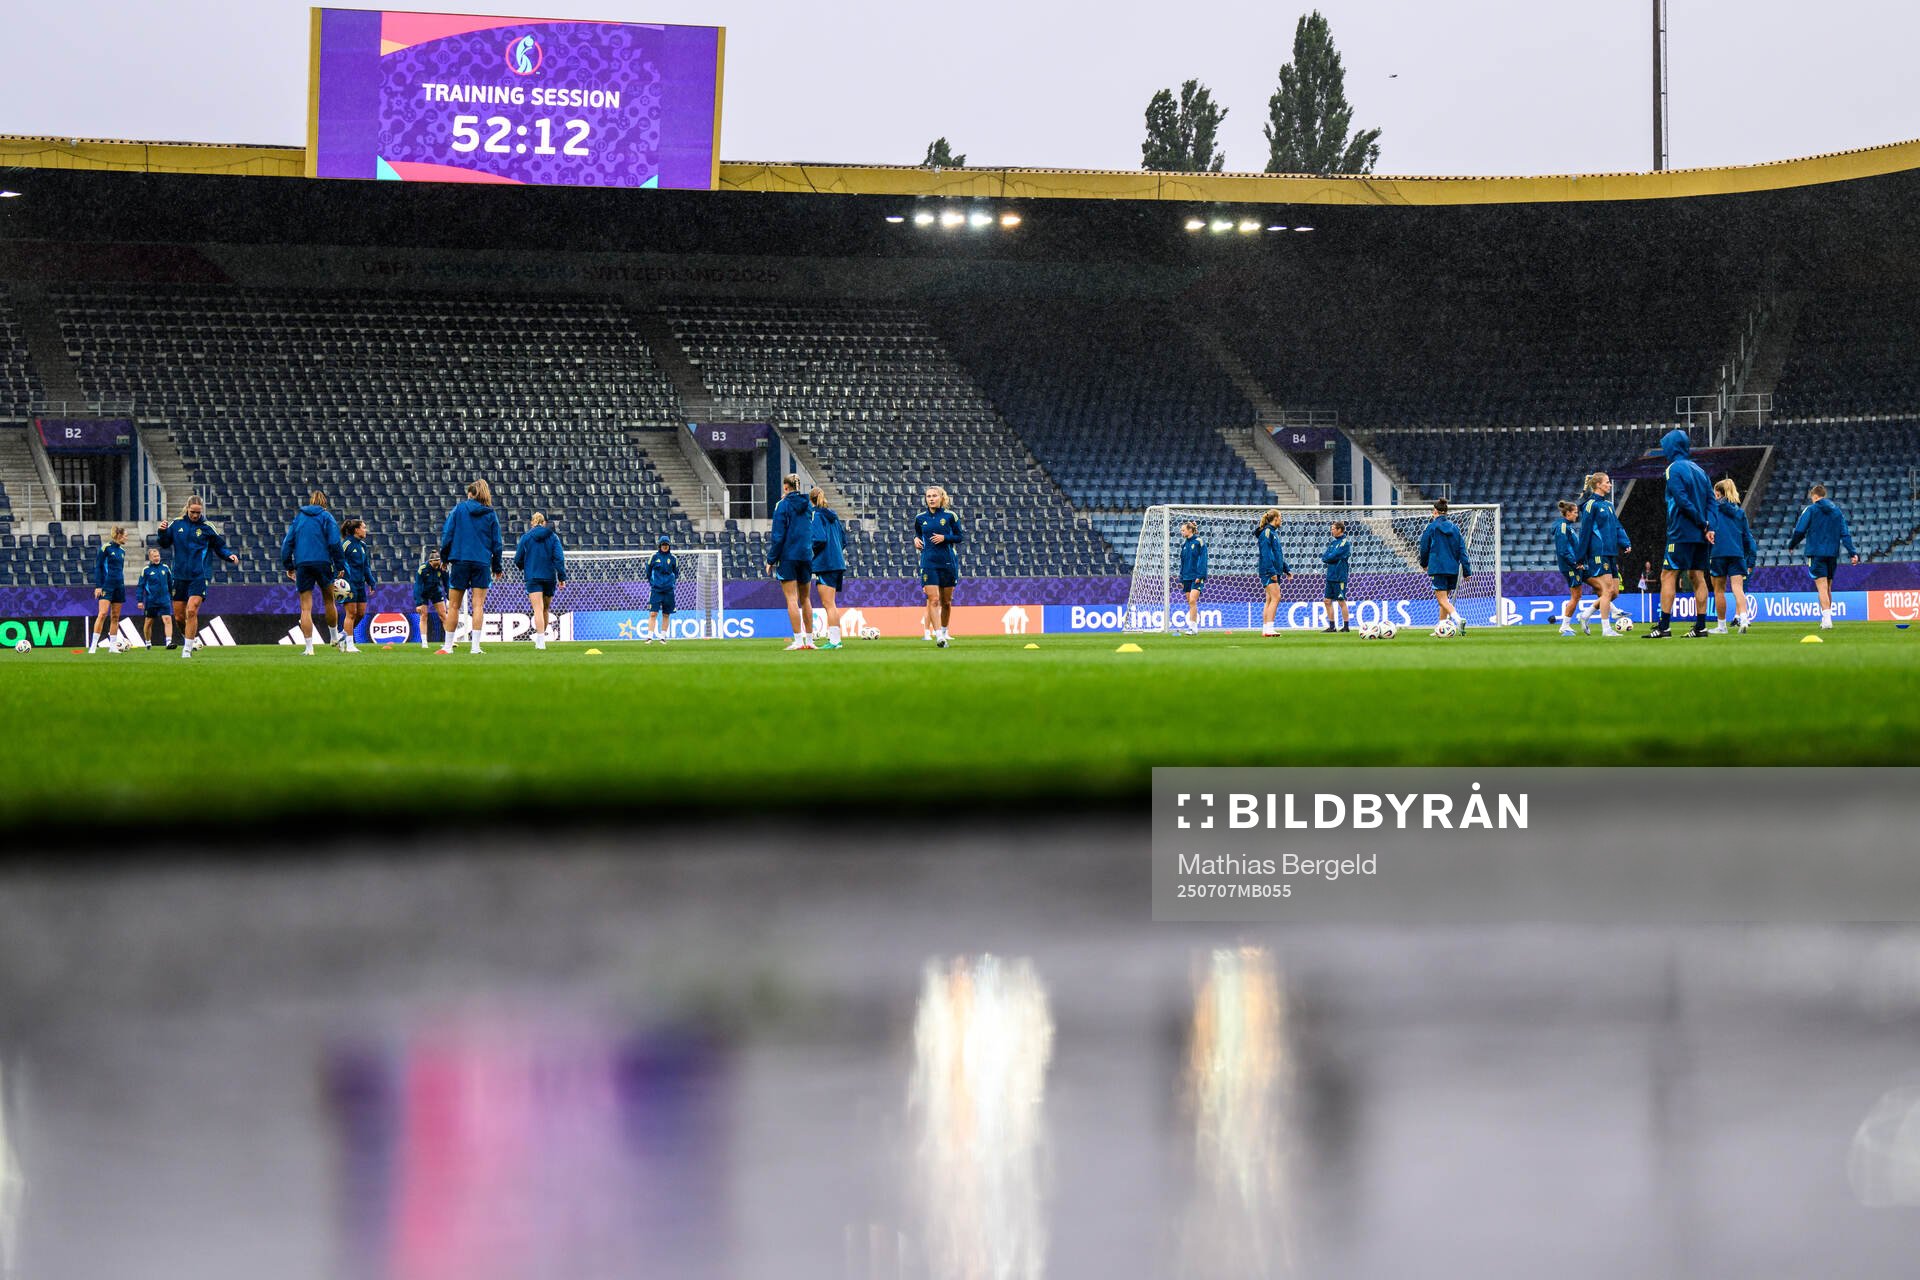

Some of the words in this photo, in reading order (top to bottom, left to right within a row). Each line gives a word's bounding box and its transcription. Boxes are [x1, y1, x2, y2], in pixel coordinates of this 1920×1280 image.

[422, 83, 525, 105] TRAINING
[531, 88, 620, 108] SESSION
[451, 115, 590, 156] 52:12
[65, 428, 82, 439] B2
[711, 431, 727, 441] B3
[1292, 434, 1306, 444] B4
[1764, 597, 1846, 616] Volkswaen
[1884, 591, 1920, 608] amaz
[373, 625, 407, 634] PEPSI
